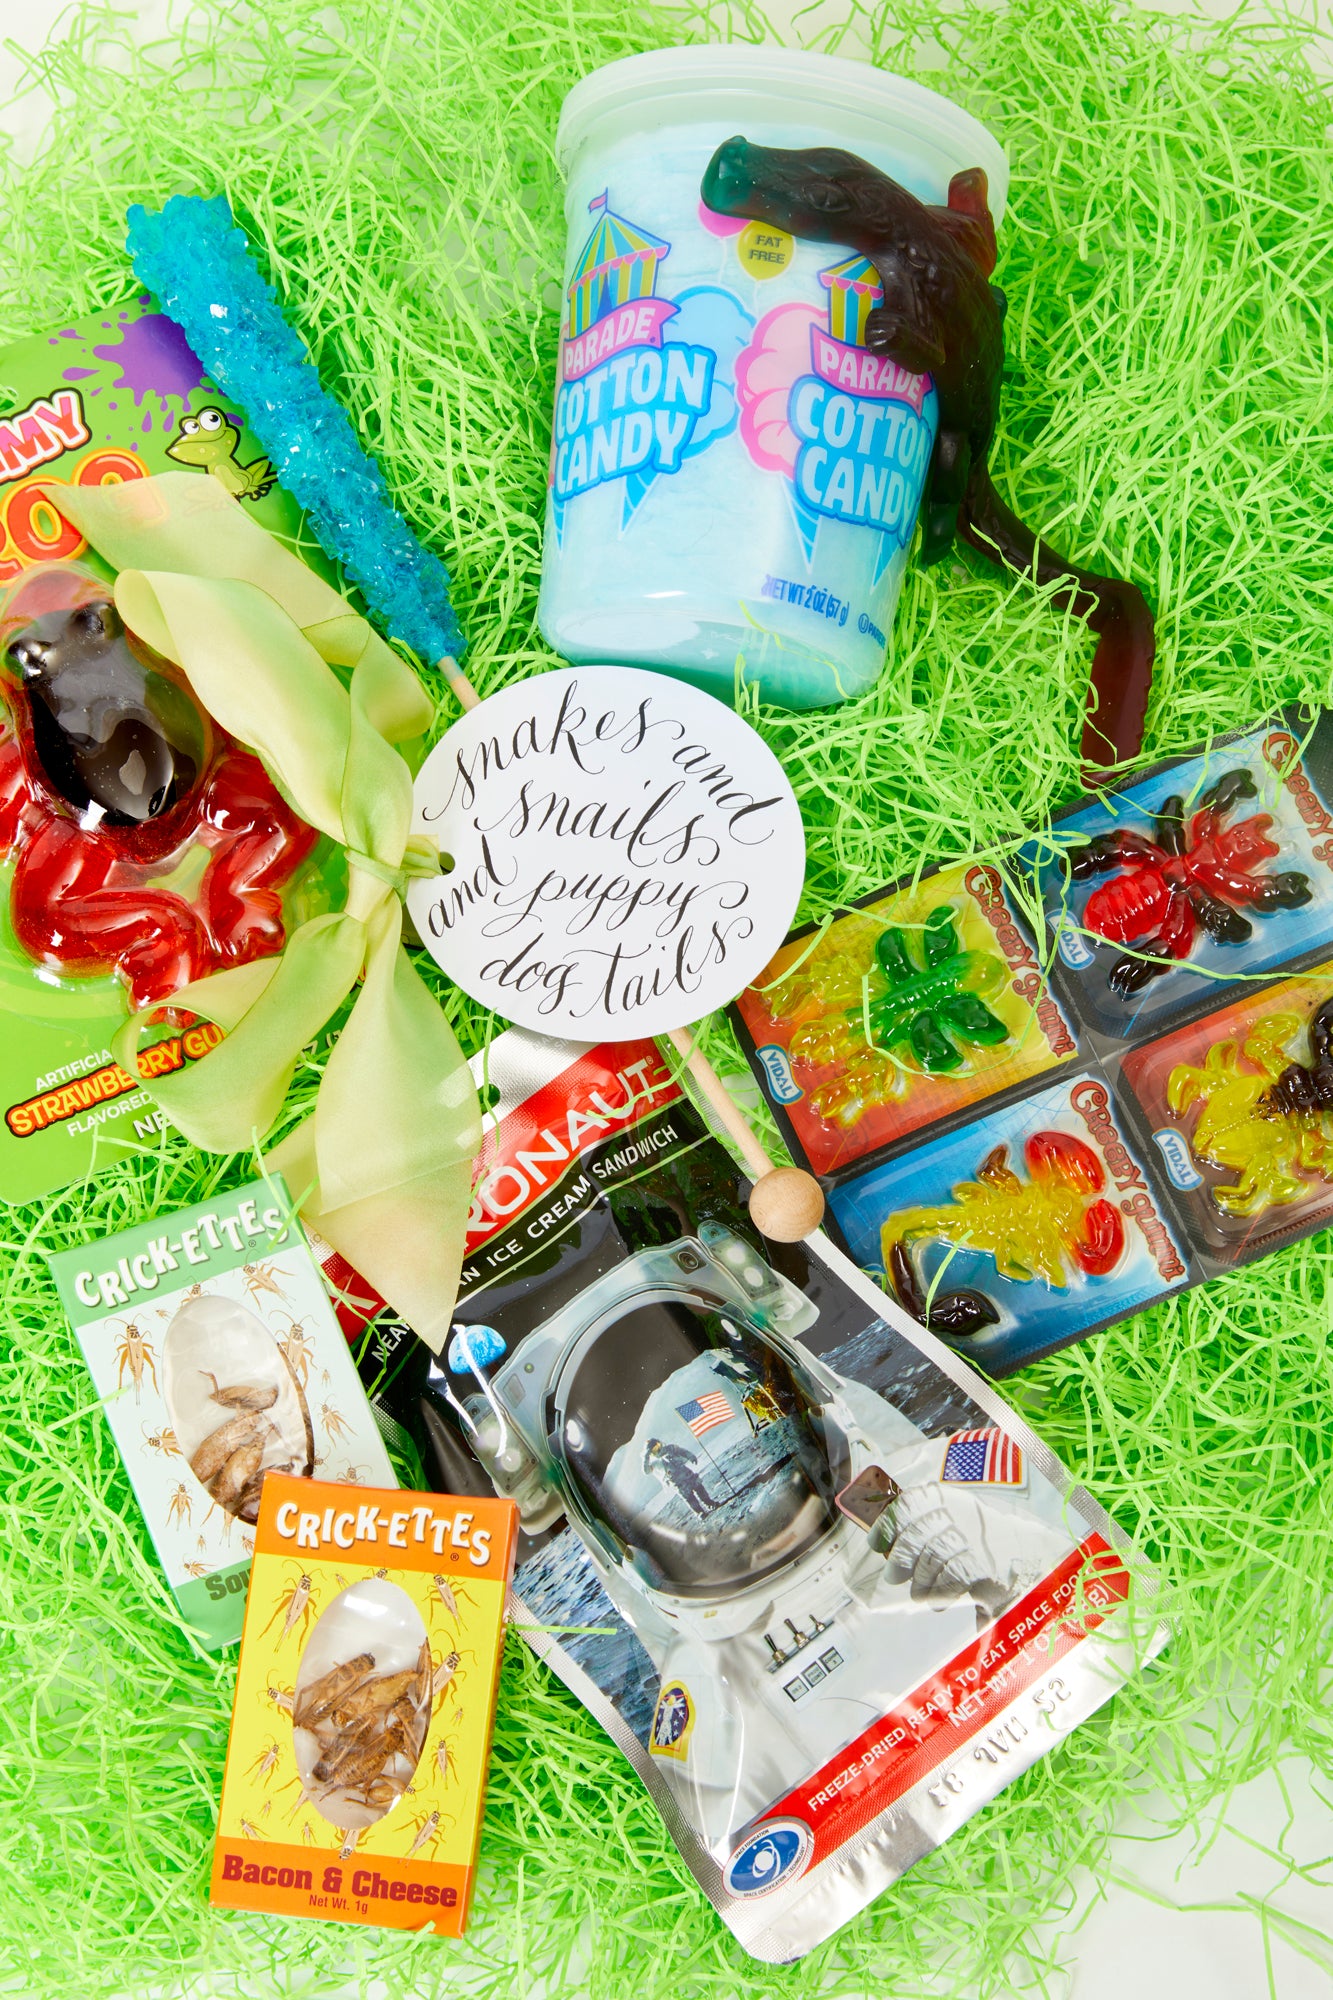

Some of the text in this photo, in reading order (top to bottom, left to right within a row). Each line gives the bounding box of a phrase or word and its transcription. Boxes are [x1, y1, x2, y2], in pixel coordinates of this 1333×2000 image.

[749, 249, 785, 264] FREE
[756, 234, 783, 248] FAT
[565, 307, 655, 376] PARADE
[819, 339, 925, 401] PARADE
[556, 349, 708, 440] COTTON
[556, 409, 690, 495] CANDY
[796, 382, 932, 484] COTTON
[802, 446, 918, 540] CANDY
[787, 582, 807, 605] WT
[422, 680, 784, 845] snakes and
[474, 780, 720, 867] snails
[428, 834, 749, 938] and puppy
[480, 916, 754, 1018] dog tails
[1056, 922, 1082, 962] DAL
[35, 1049, 113, 1091] ARTIFICIA
[767, 1051, 792, 1097] VIDAL
[66, 1090, 153, 1137] FLAVORED
[1164, 1136, 1191, 1183] VIDAL
[486, 1238, 524, 1267] ICE
[526, 1174, 592, 1239] CREAM
[592, 1124, 679, 1179] SANDWICH
[74, 1199, 289, 1308] CRICK-ETTES
[1120, 1193, 1186, 1283] gummi
[276, 1502, 492, 1566] CRICK-ETTES
[807, 1727, 907, 1811] FREEZE-DRIED
[907, 1684, 955, 1730] READY
[955, 1666, 980, 1689] TO
[980, 1640, 1008, 1669] EAT
[1008, 1600, 1053, 1645] SPACE
[948, 1691, 986, 1728] NET
[986, 1667, 1019, 1696] WT
[222, 1854, 457, 1907] Bacon & Cheese
[309, 1894, 369, 1914] Net Wt. 1g
